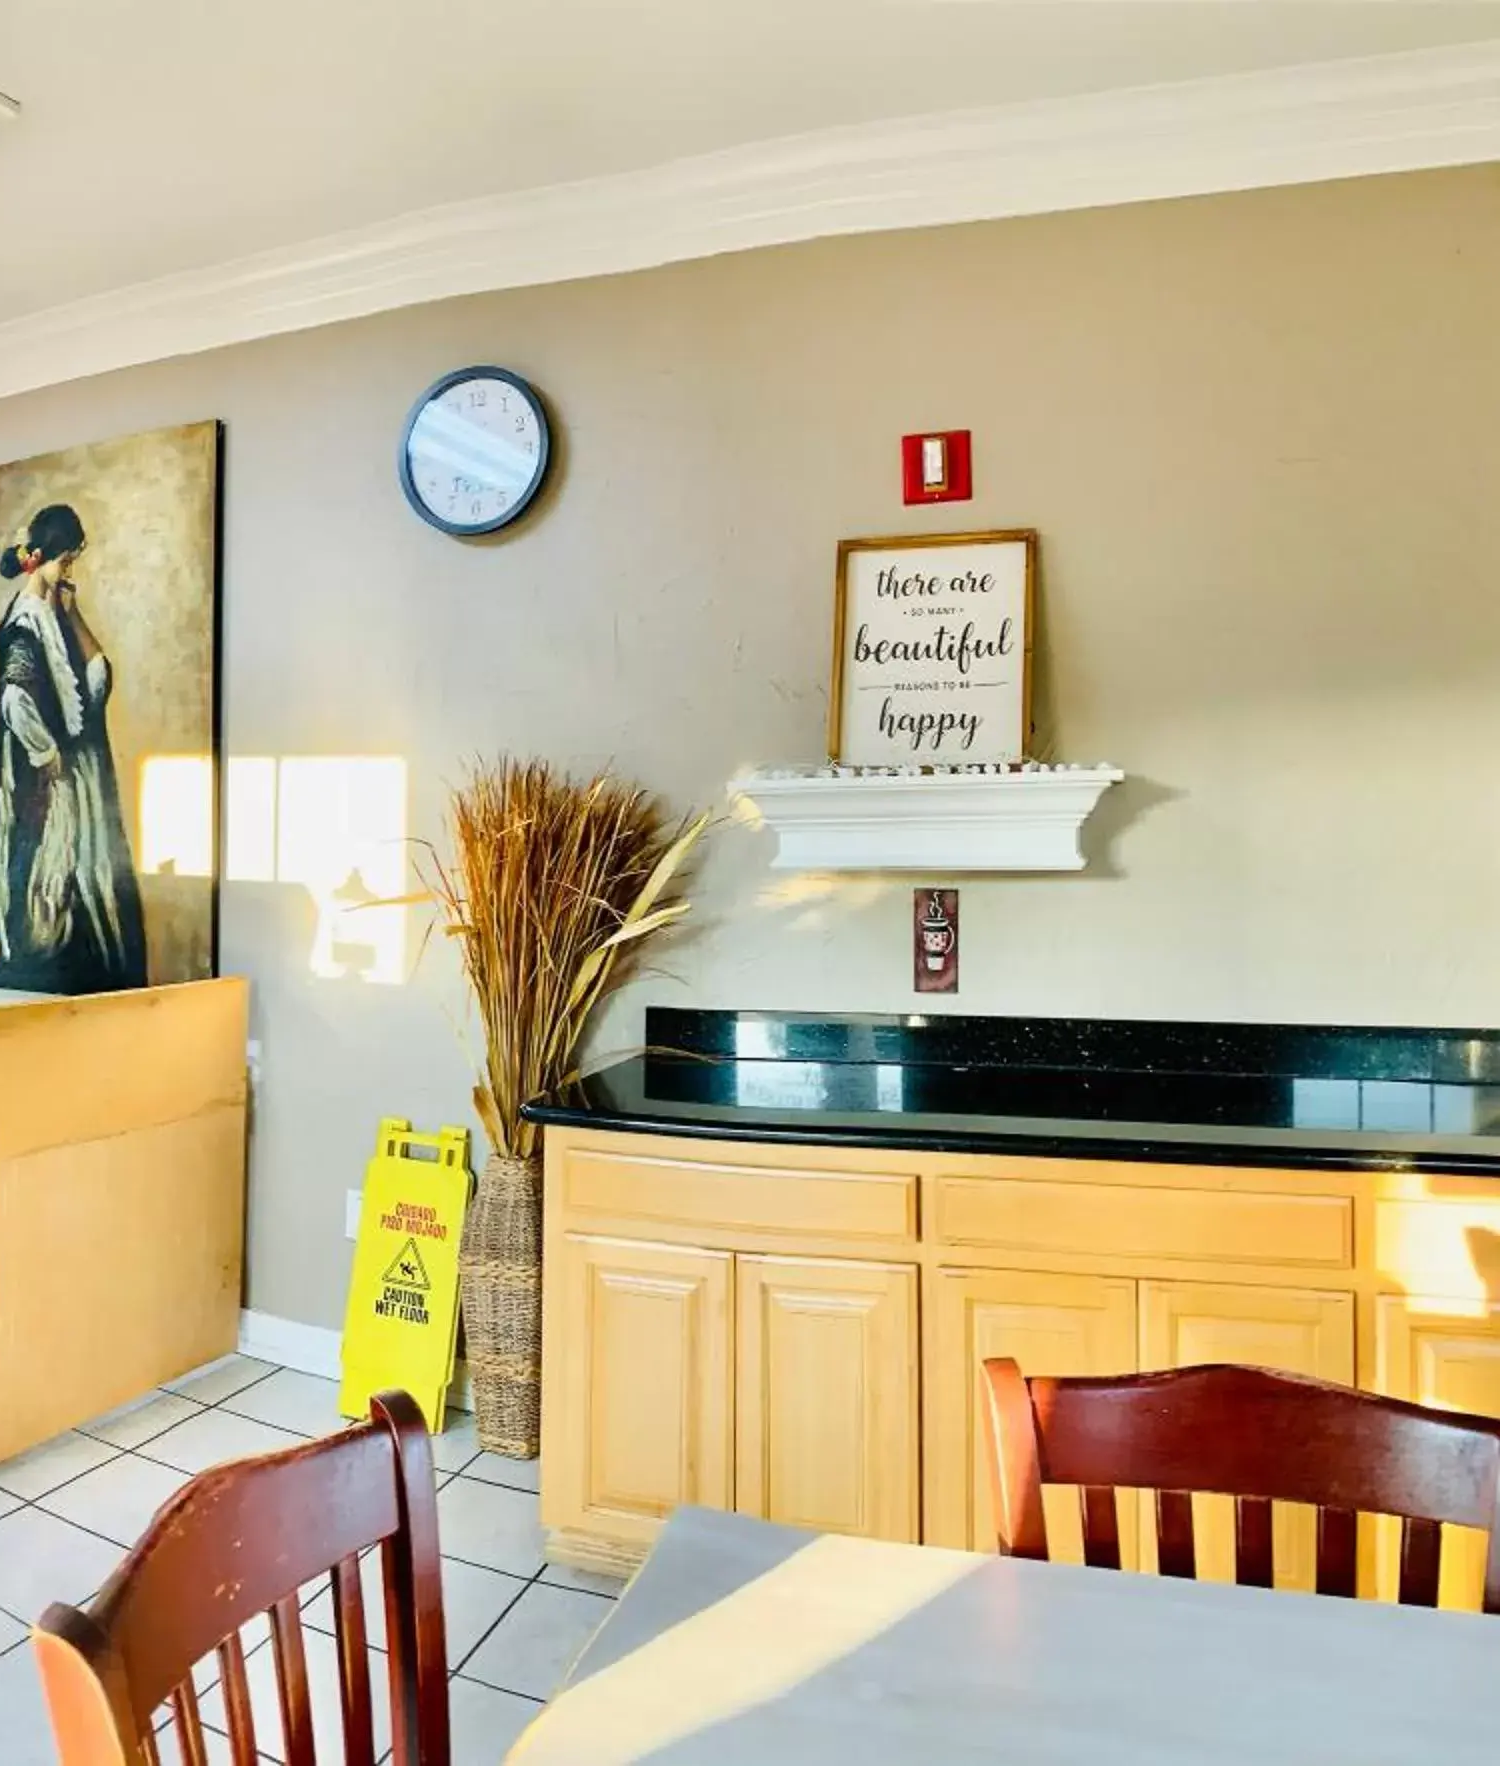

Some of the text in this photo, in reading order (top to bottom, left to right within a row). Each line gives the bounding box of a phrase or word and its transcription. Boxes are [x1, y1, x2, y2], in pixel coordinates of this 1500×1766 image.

[876, 564, 997, 599] there are
[853, 617, 1014, 675] beautiful
[878, 696, 984, 751] happy
[395, 1201, 437, 1222] CUIDADO
[375, 1299, 429, 1325] WET FLOOR
[383, 1286, 425, 1309] CAUTION
